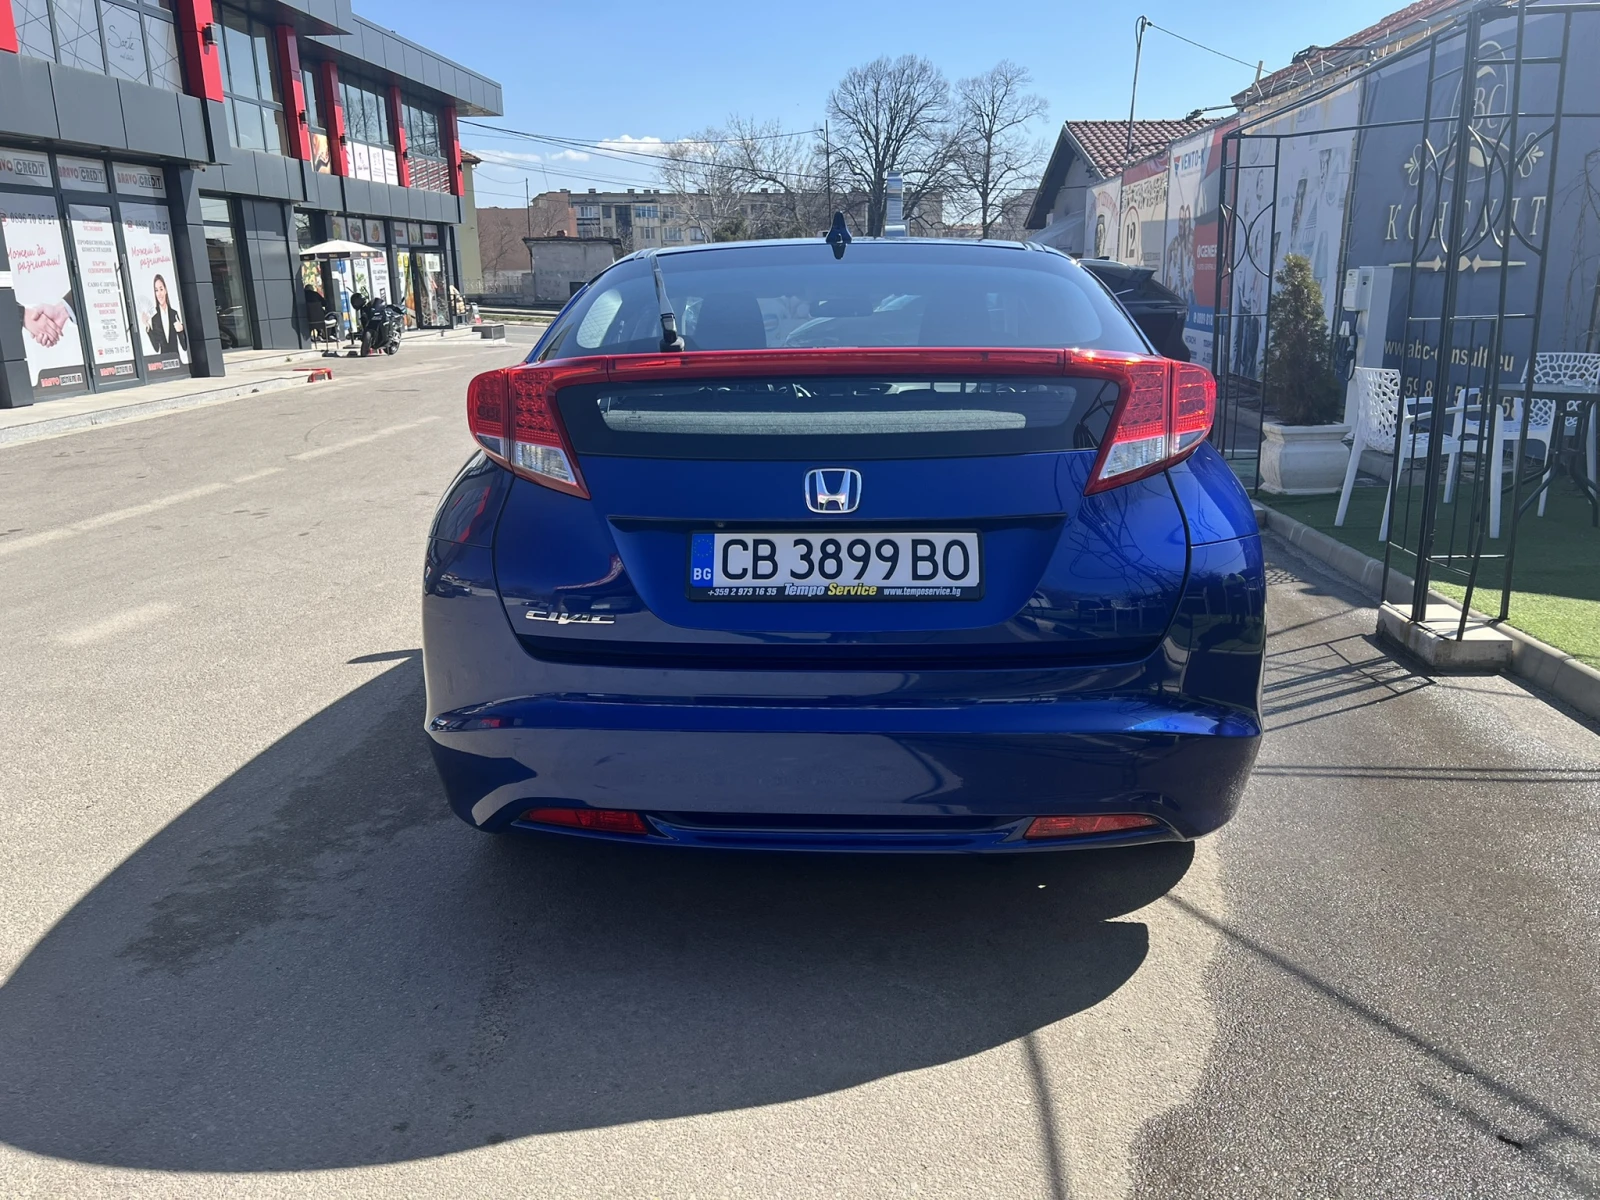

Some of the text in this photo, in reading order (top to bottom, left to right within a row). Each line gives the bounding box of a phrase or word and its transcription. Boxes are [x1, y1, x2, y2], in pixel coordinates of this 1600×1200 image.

[721, 538, 970, 581] CB 3899 BO
[693, 567, 712, 581] BG
[707, 582, 961, 598] +359 2 973 16 35 Tempo Service www.temposervice.bg
